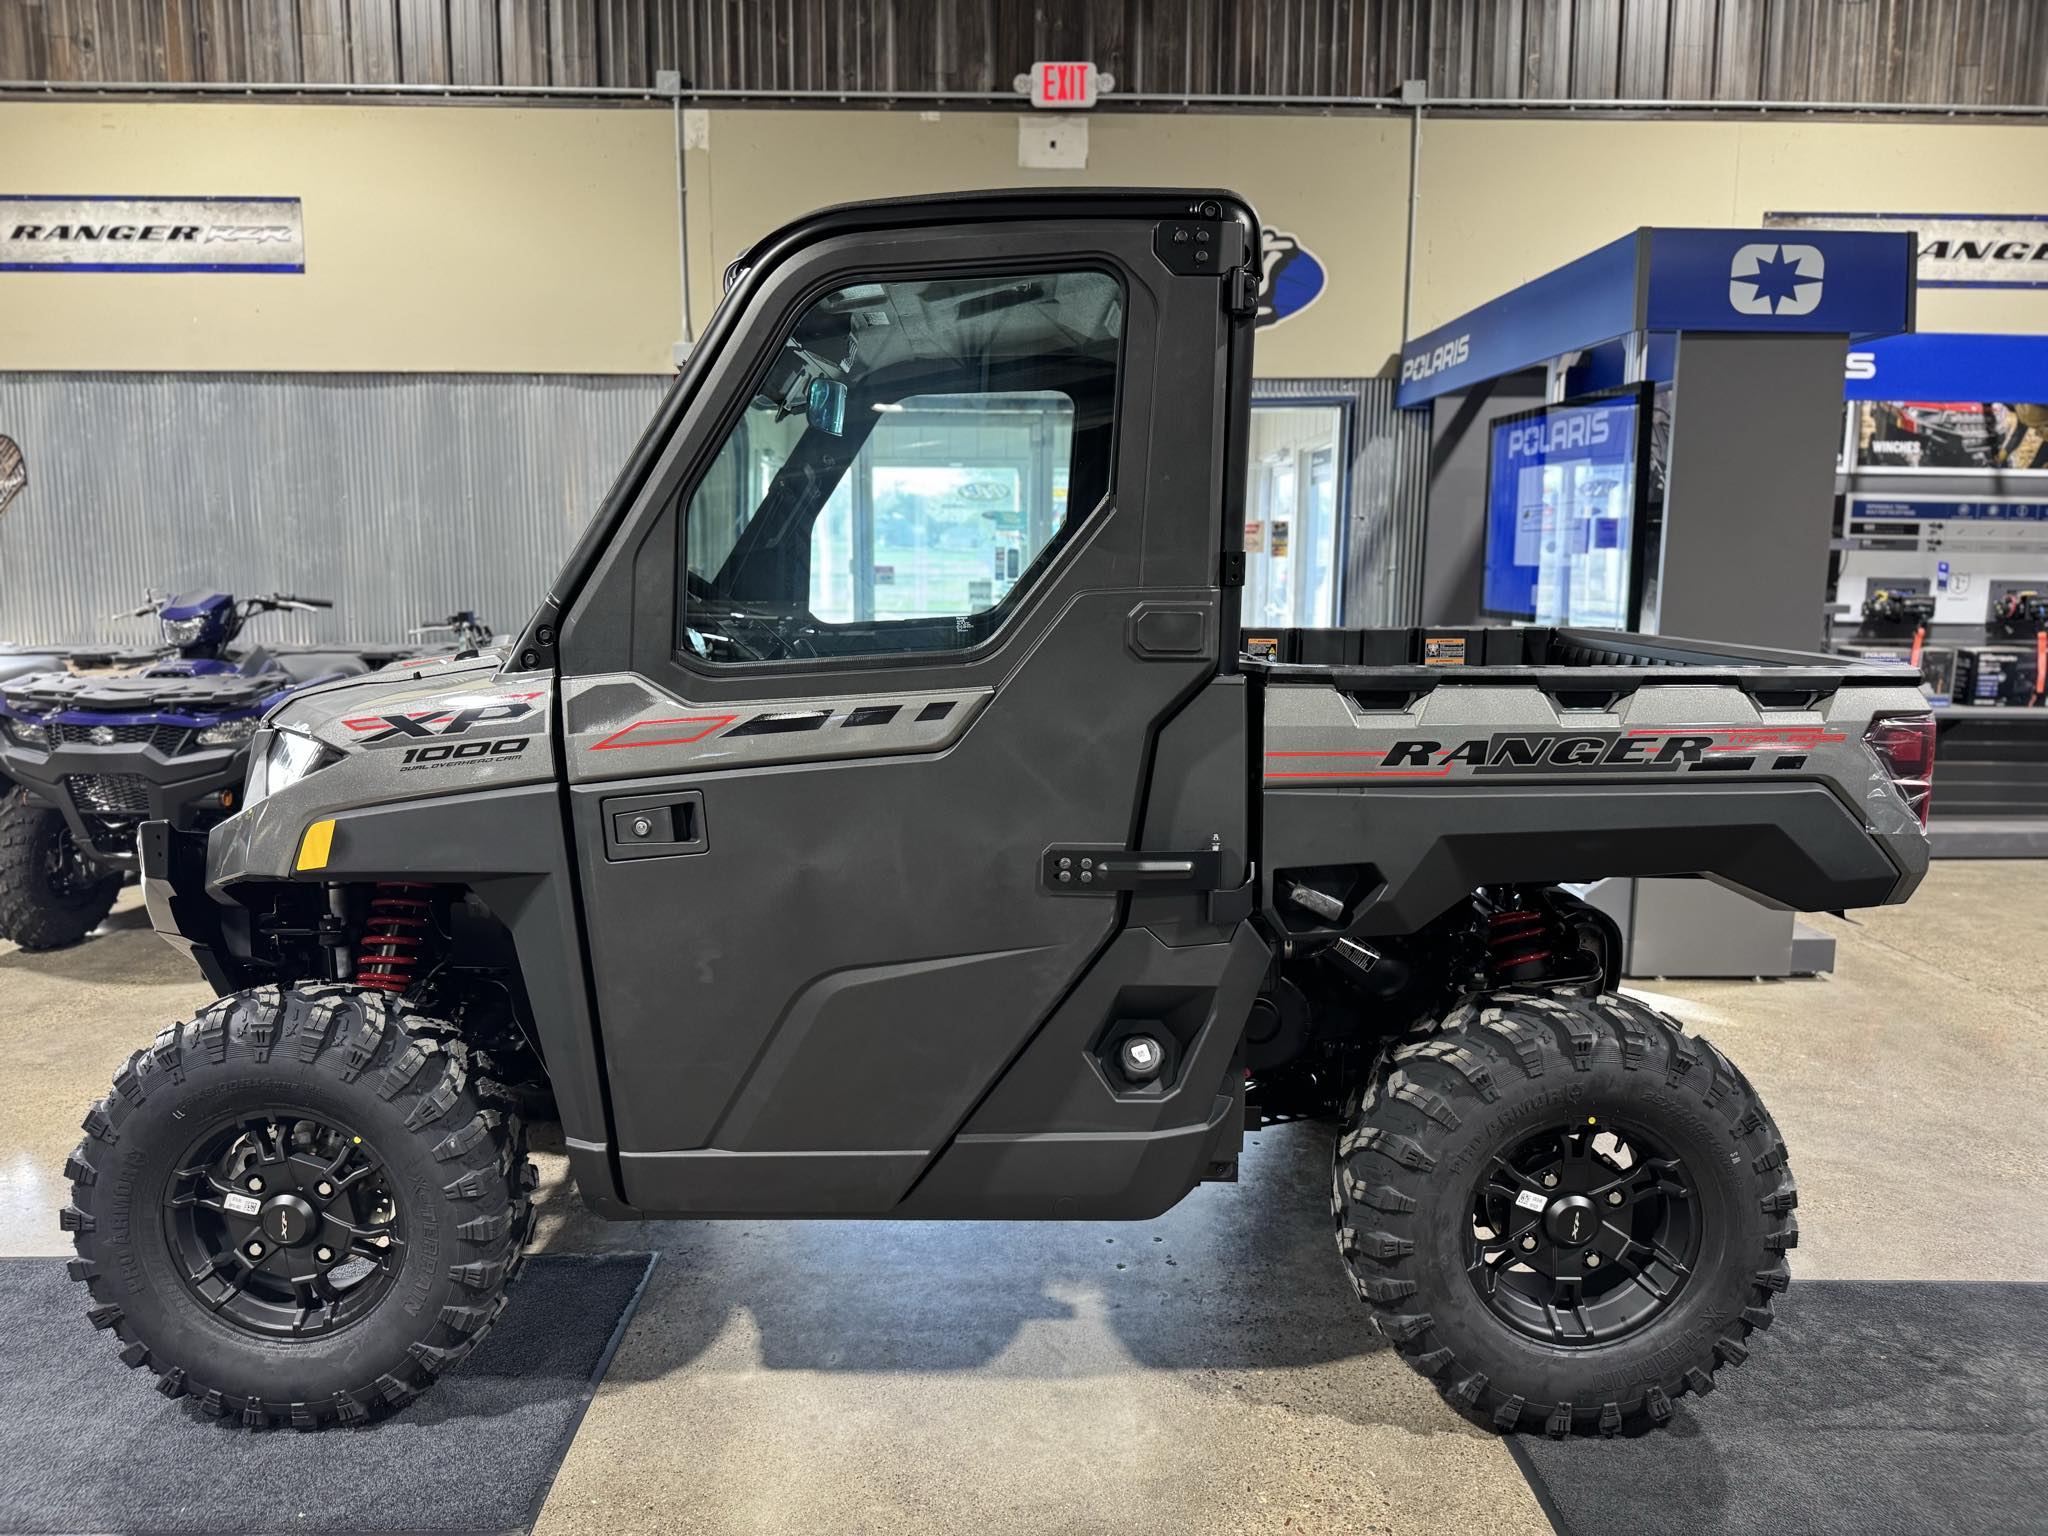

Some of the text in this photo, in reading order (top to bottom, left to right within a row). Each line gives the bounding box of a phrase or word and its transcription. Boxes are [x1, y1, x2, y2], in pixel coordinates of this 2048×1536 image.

[1042, 64, 1089, 102] EXIT
[9, 224, 201, 241] RANGER
[1917, 240, 2048, 260] ANGE
[1401, 334, 1470, 385] POLARIS
[1508, 410, 1610, 459] POLARIS
[355, 702, 534, 744] XP
[399, 754, 522, 772] DUAL OVERHEAD CAM
[402, 737, 530, 764] 1000
[1379, 736, 1716, 768] RANGER
